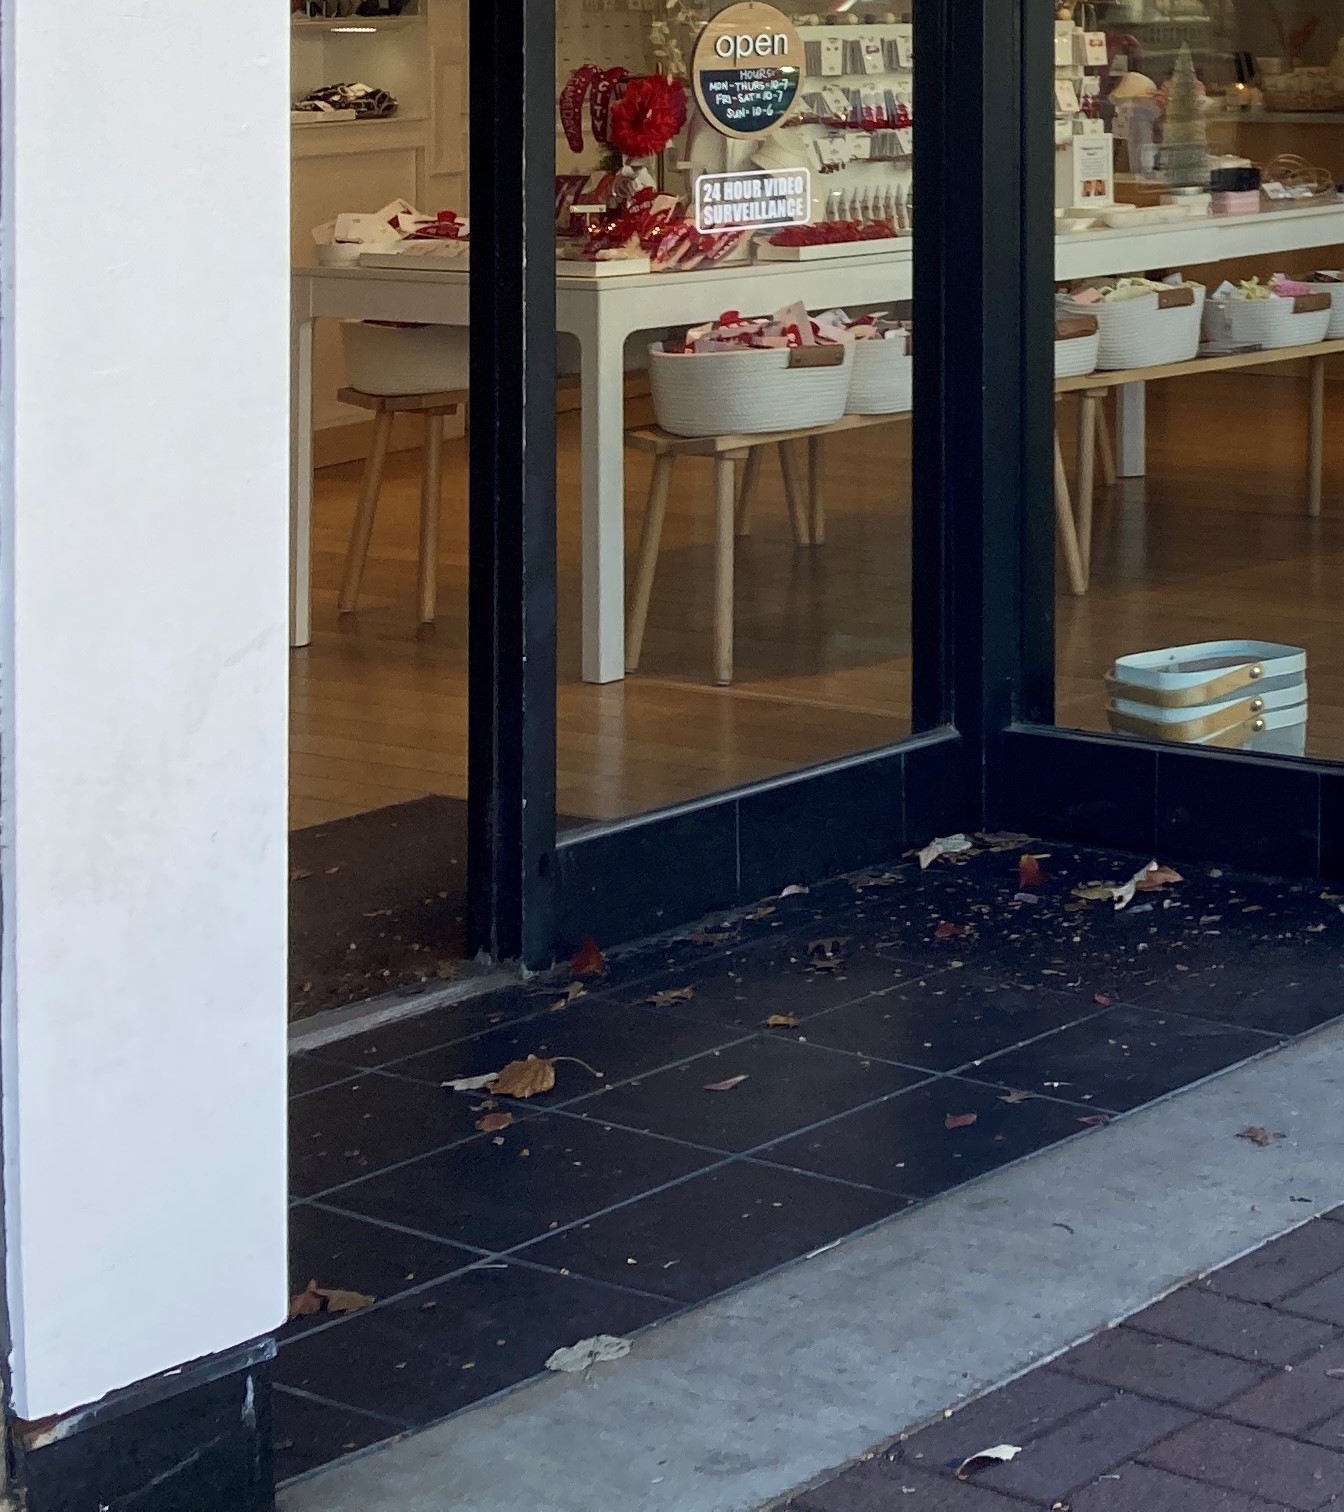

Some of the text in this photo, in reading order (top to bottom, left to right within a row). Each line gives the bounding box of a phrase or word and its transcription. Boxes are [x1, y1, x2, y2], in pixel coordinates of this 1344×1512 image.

[715, 33, 788, 61] open
[703, 176, 803, 202] 24 HOUR VIDEO
[703, 198, 803, 225] SURVEILLANCE
